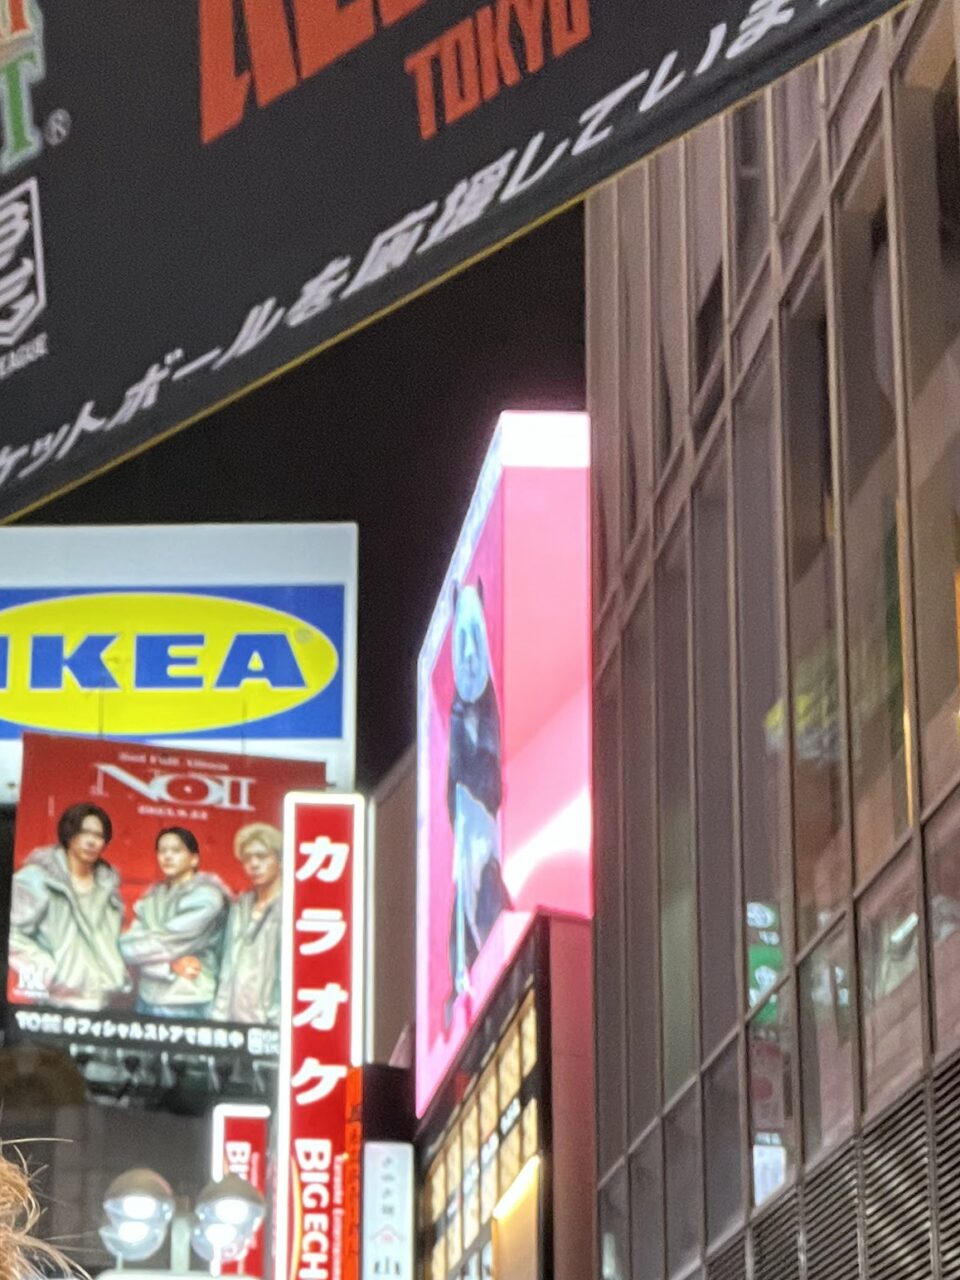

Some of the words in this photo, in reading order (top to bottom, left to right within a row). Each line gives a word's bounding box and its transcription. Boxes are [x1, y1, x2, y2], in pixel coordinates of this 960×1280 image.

[404, 0, 591, 141] TOKYO
[290, 835, 349, 1106] カラオケ
[225, 1141, 252, 1181] BI
